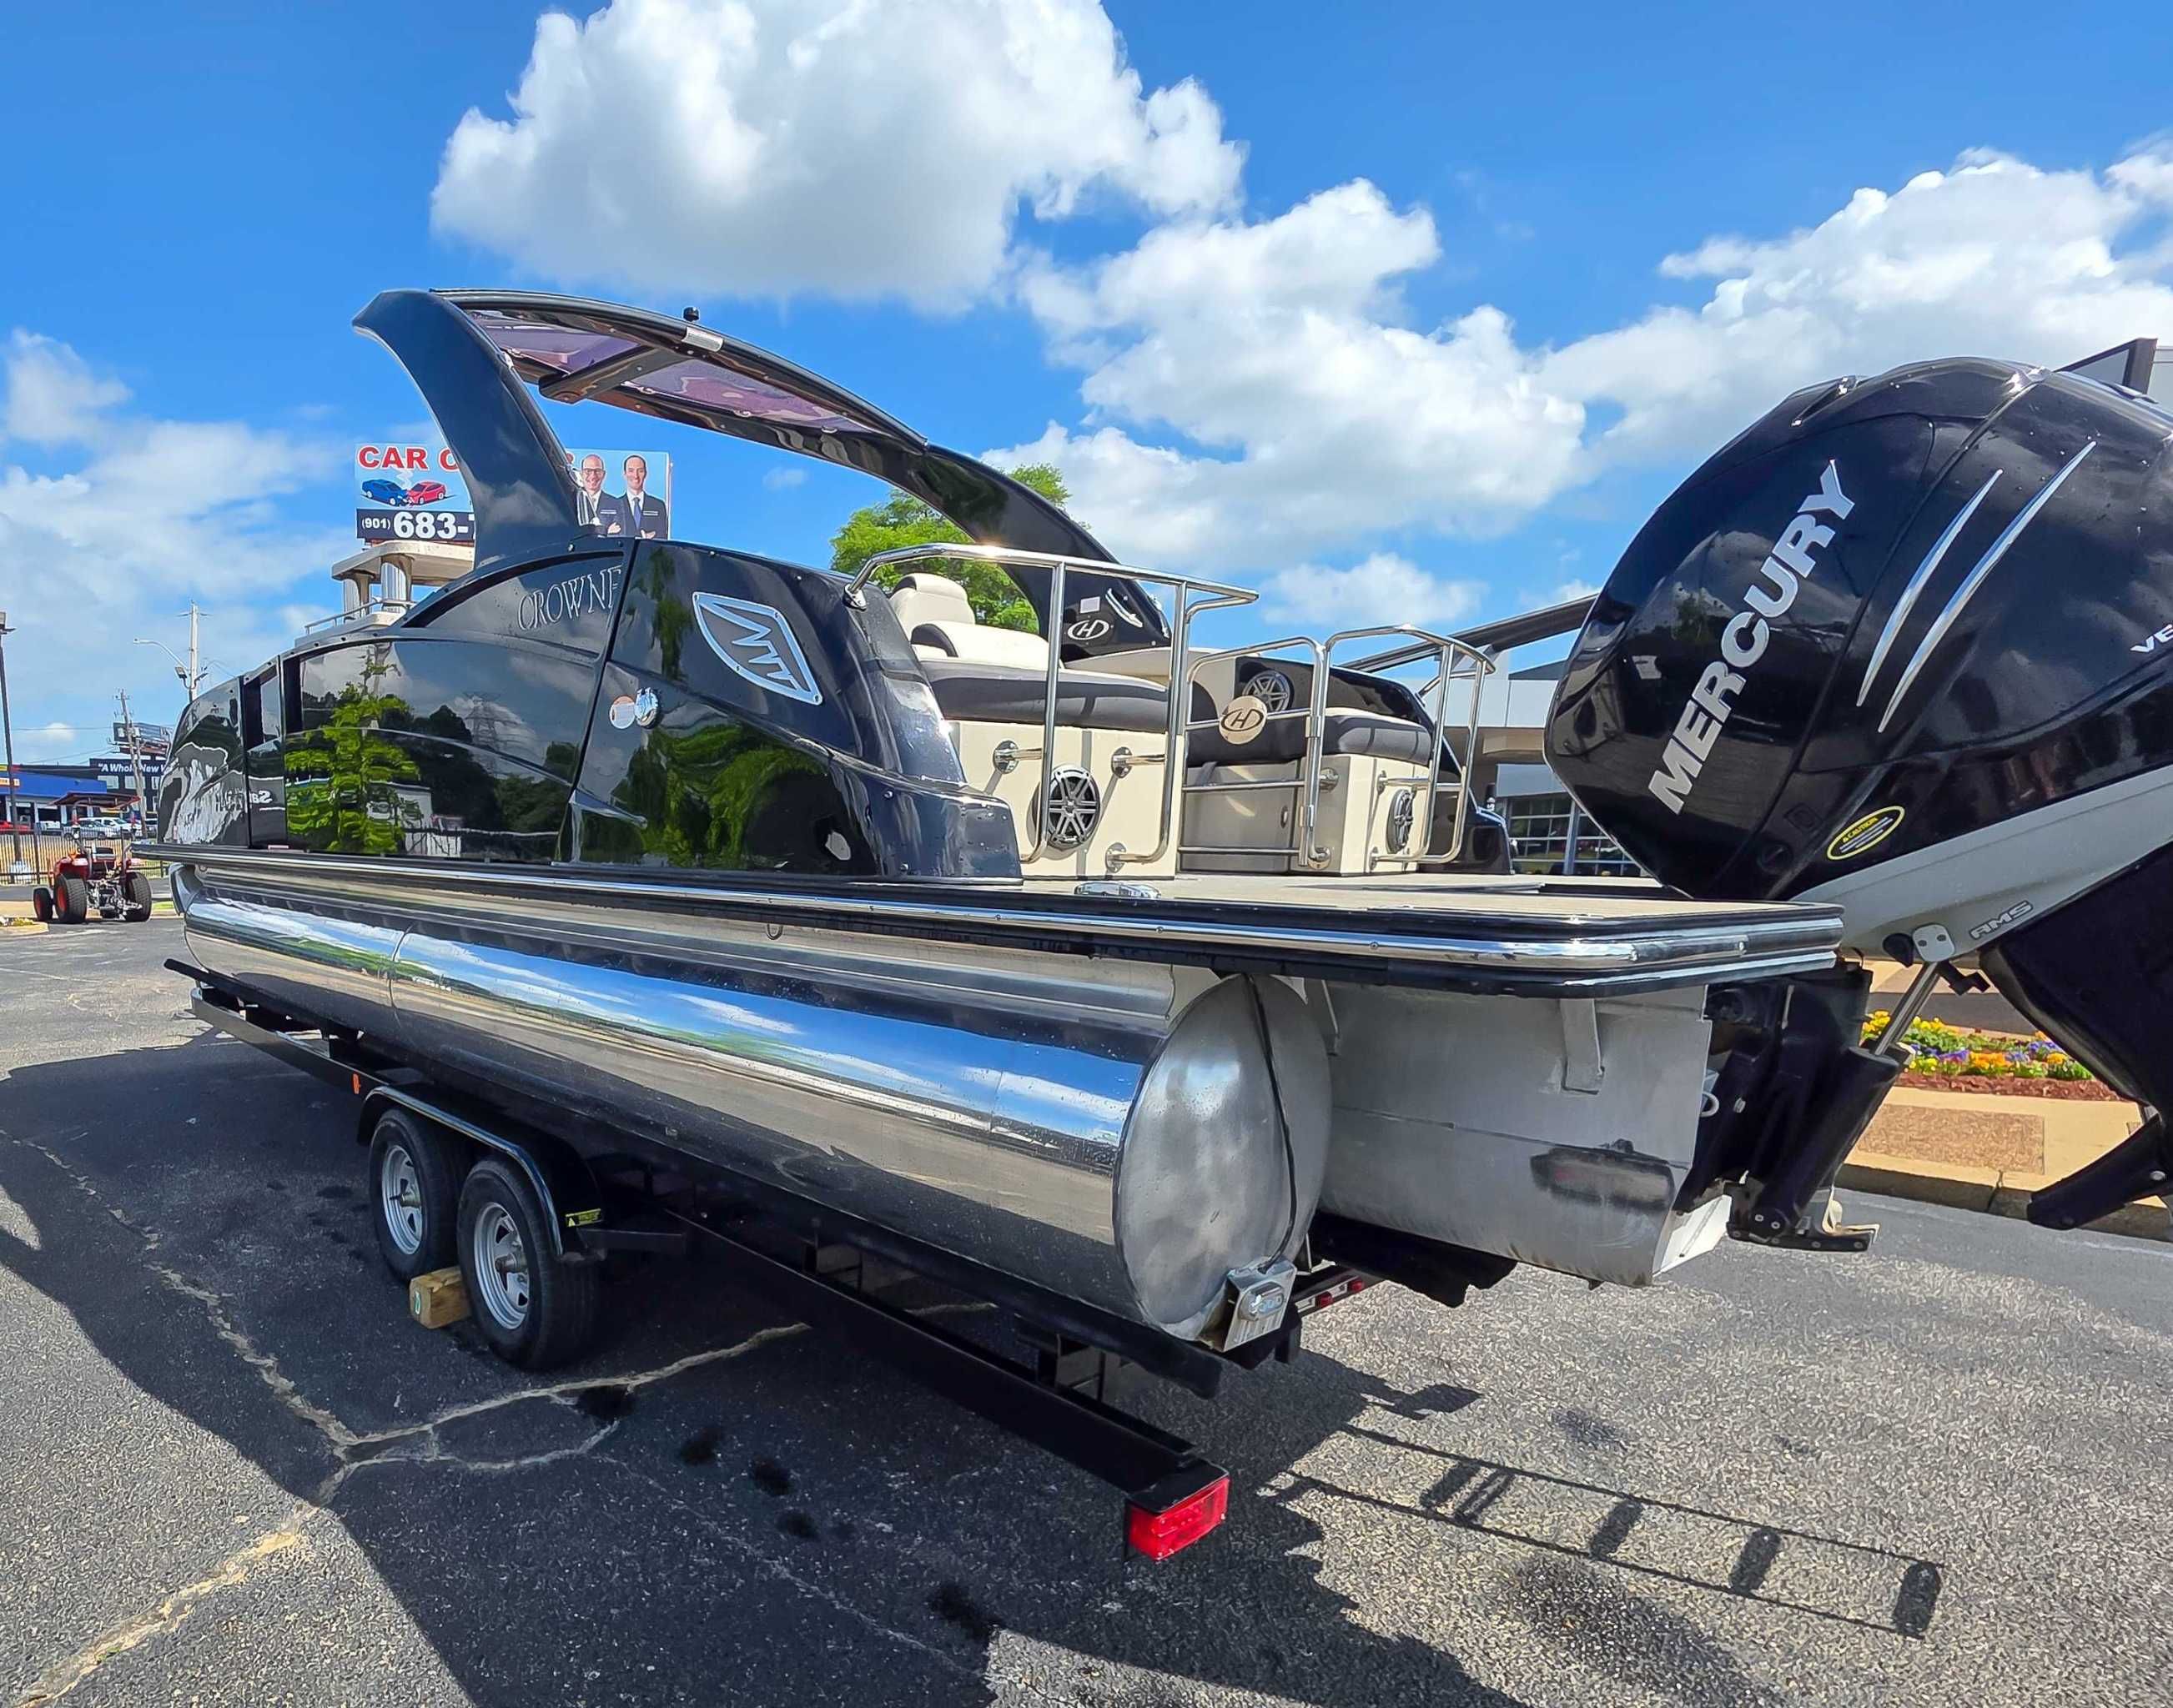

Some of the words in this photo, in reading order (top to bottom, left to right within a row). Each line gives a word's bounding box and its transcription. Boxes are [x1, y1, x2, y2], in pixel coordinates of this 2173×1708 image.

[358, 445, 429, 470] CAR
[361, 517, 391, 530] (901)
[1647, 459, 1855, 816] MERCURY
[109, 762, 133, 773] Whol
[1969, 900, 2033, 940] AMS
